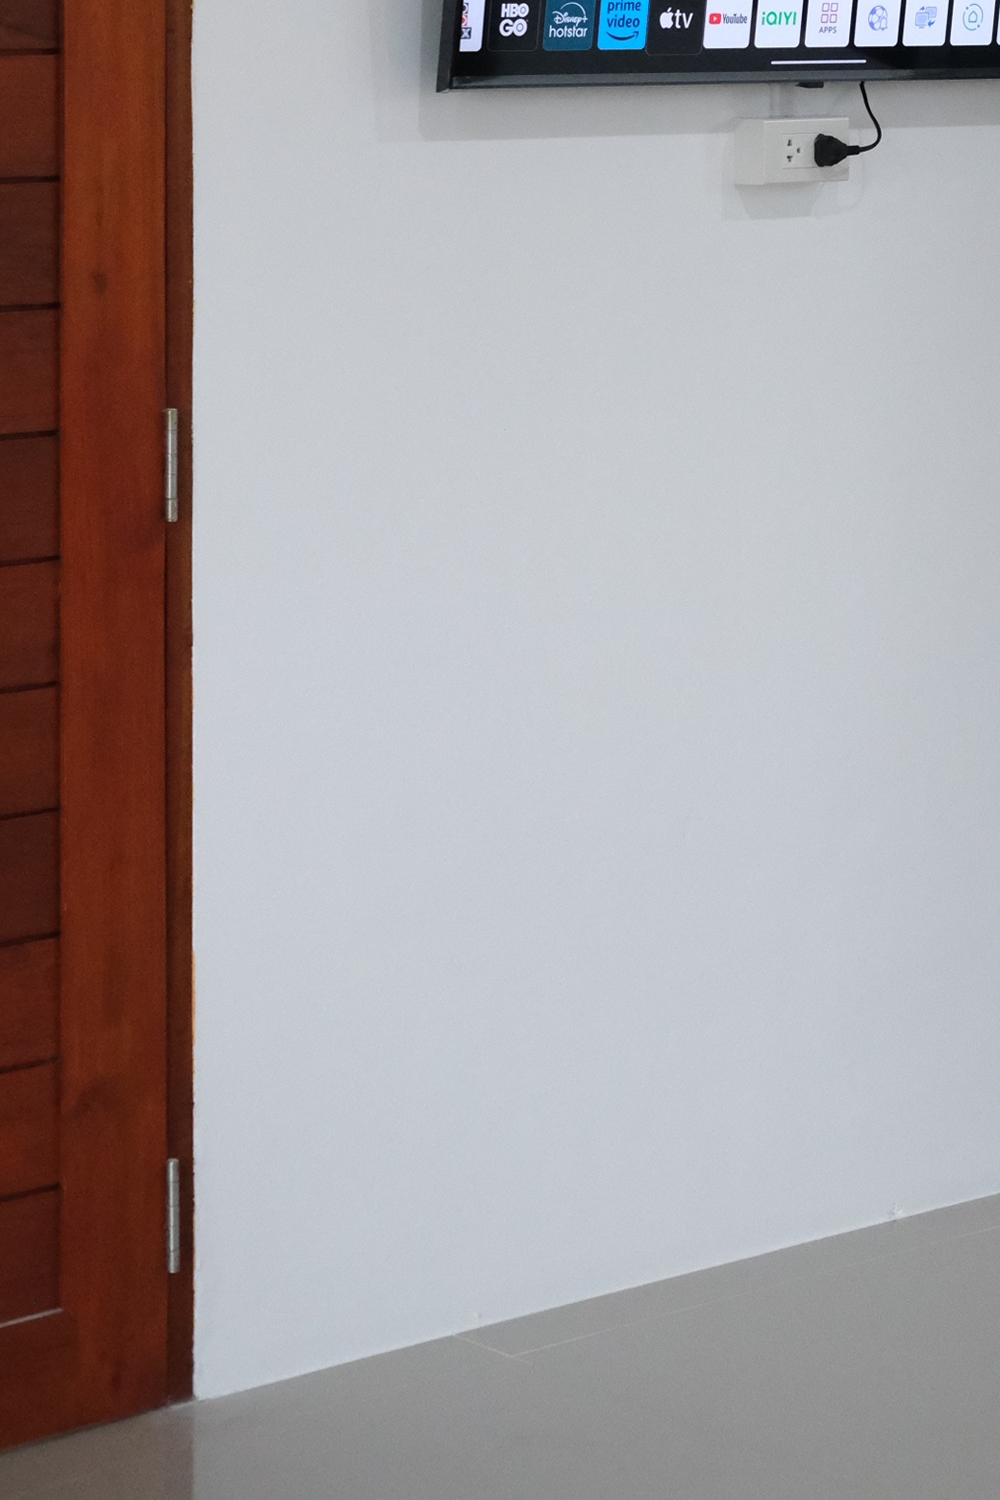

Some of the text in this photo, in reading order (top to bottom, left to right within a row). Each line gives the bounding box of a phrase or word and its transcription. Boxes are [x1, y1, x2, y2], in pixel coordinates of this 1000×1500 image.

[501, 3, 529, 18] HBO
[607, 0, 641, 12] prime
[607, 18, 640, 29] video
[675, 10, 693, 28] tv
[722, 13, 748, 25] YouTube
[761, 11, 797, 26] iQIYI
[499, 19, 528, 37] GO
[549, 25, 587, 38] hotstar
[819, 26, 837, 34] APPS
